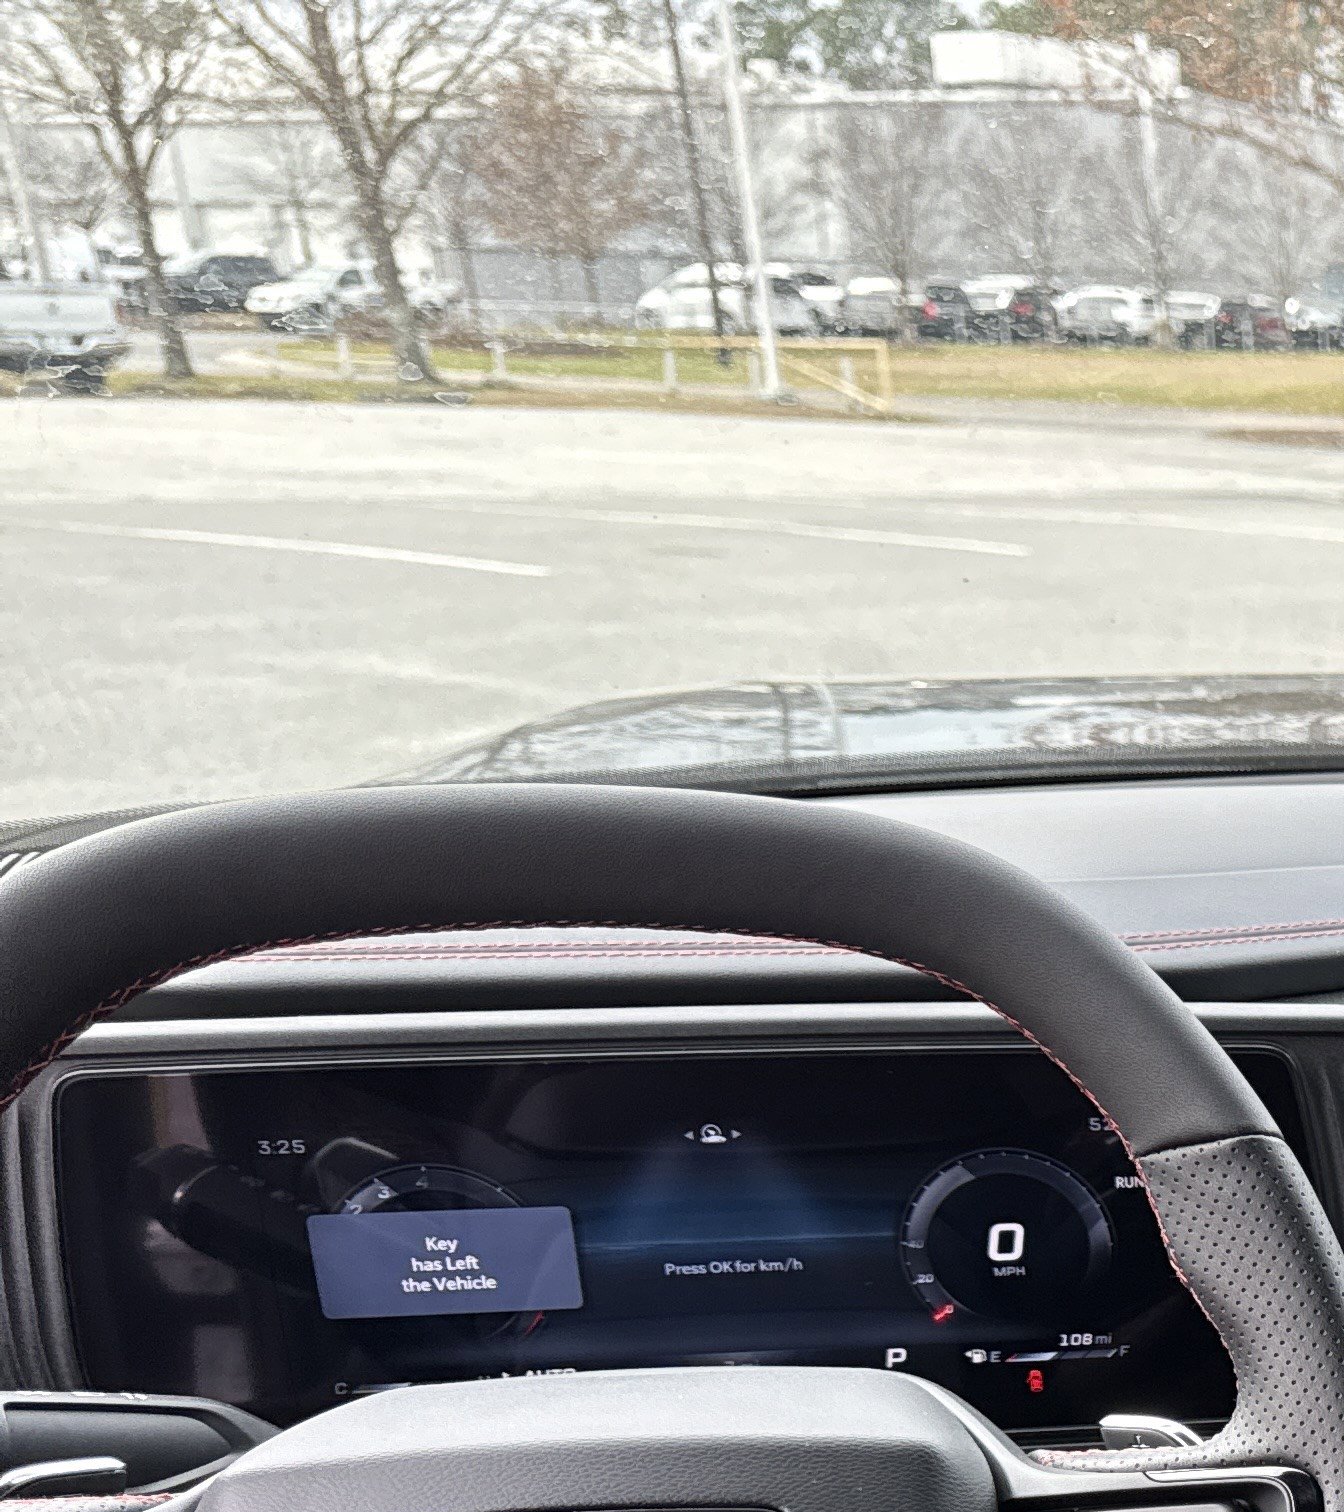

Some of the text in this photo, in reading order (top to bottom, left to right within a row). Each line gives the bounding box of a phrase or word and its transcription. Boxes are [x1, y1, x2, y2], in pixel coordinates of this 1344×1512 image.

[257, 1139, 306, 1155] 3:25
[377, 1186, 391, 1199] 3
[425, 1236, 458, 1253] Key
[987, 1222, 1025, 1262] 0
[411, 1255, 480, 1272] has Left
[664, 1257, 804, 1276] Press OK for km/h
[993, 1265, 1026, 1277] MPH
[401, 1275, 498, 1293] the Vehicle
[1058, 1331, 1112, 1347] 108 mi
[885, 1347, 907, 1368] P
